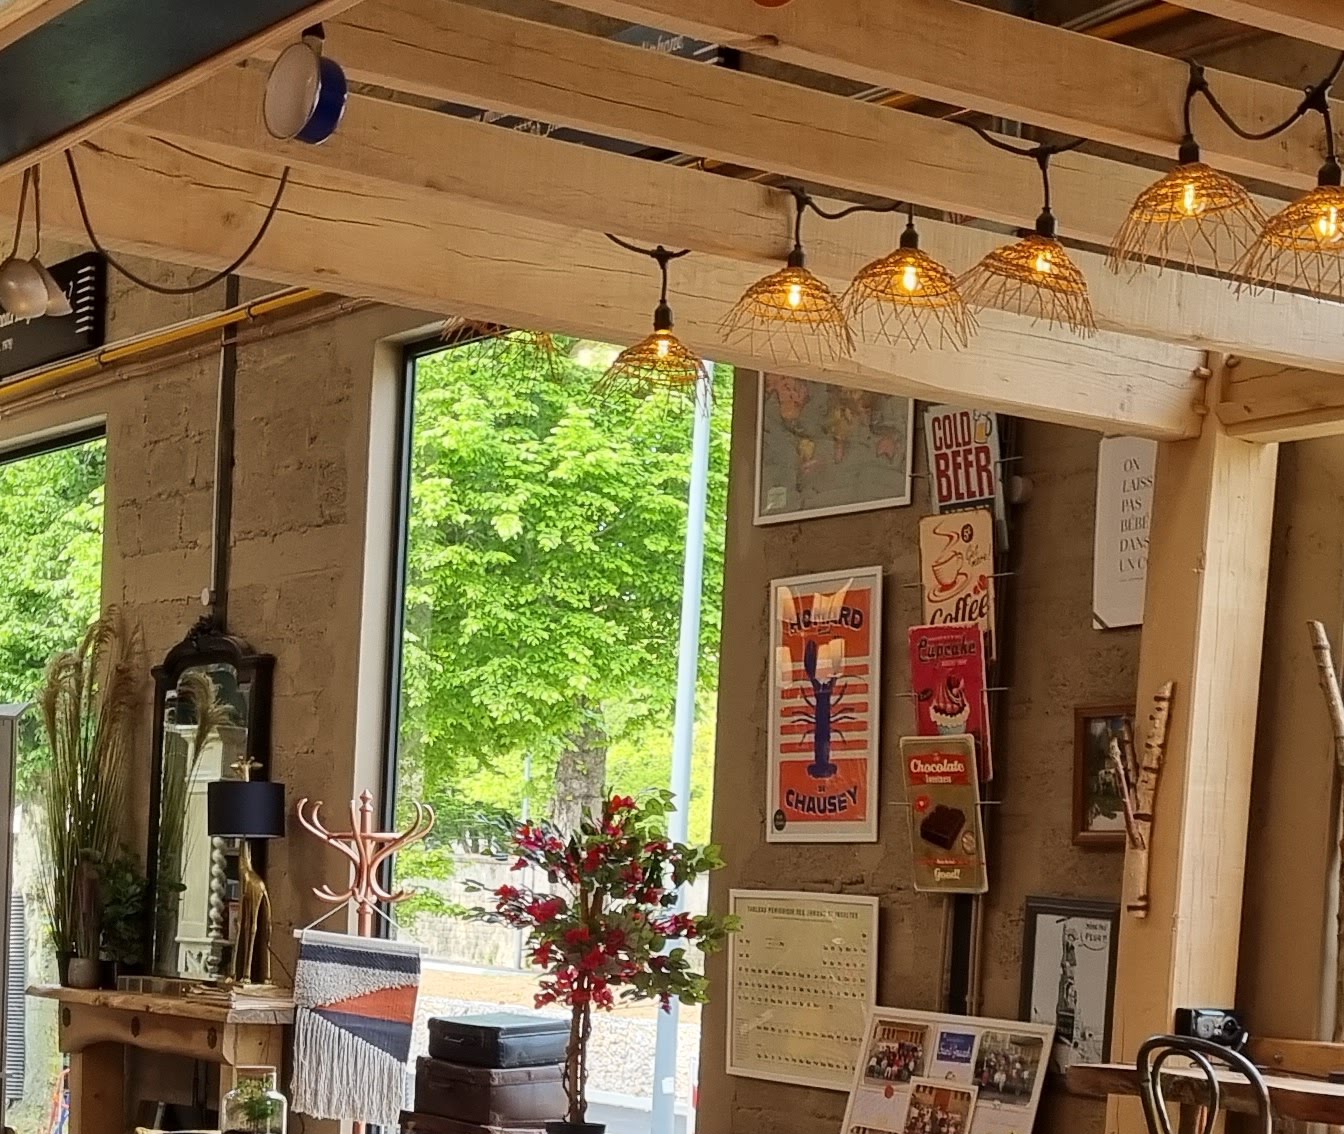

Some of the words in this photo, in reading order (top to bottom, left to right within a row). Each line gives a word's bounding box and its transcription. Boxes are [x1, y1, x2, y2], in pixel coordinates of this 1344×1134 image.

[931, 411, 972, 452] COLD
[935, 445, 995, 504] BEER
[1123, 457, 1140, 472] ON
[1122, 476, 1153, 493] LAISS
[1121, 499, 1142, 513] PAS
[788, 606, 864, 635] HORD
[930, 593, 989, 625] Coffee
[918, 632, 977, 662] Cupcake
[910, 758, 965, 774] Chocolate
[785, 785, 858, 815] CHAUSEY
